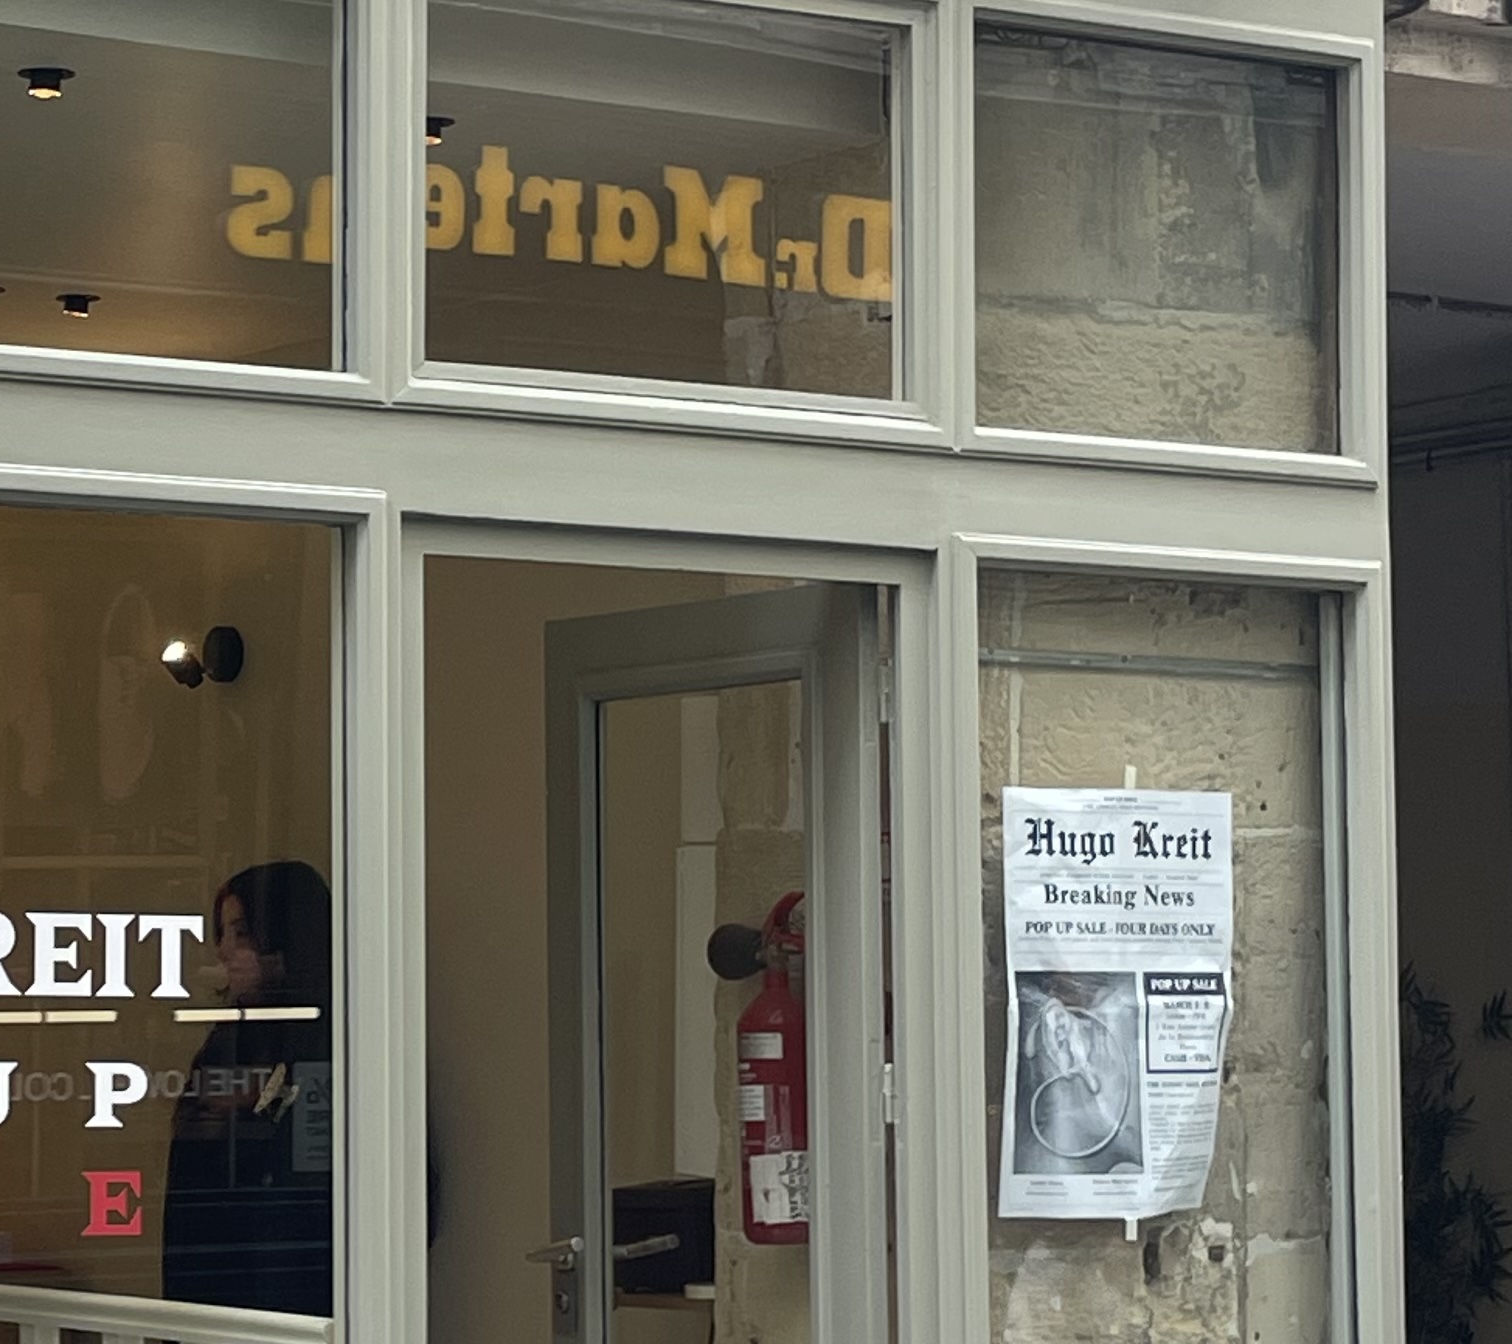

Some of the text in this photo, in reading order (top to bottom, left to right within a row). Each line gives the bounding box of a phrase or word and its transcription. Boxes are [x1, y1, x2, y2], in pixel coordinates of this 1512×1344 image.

[1024, 817, 1212, 866] Hugo Kreit
[1043, 883, 1196, 911] Breaking News
[1025, 921, 1053, 935] POP
[1055, 922, 1074, 935] UP
[1076, 921, 1107, 935] SALE
[1149, 923, 1179, 937] DAYS
[1181, 923, 1216, 937] ONLY
